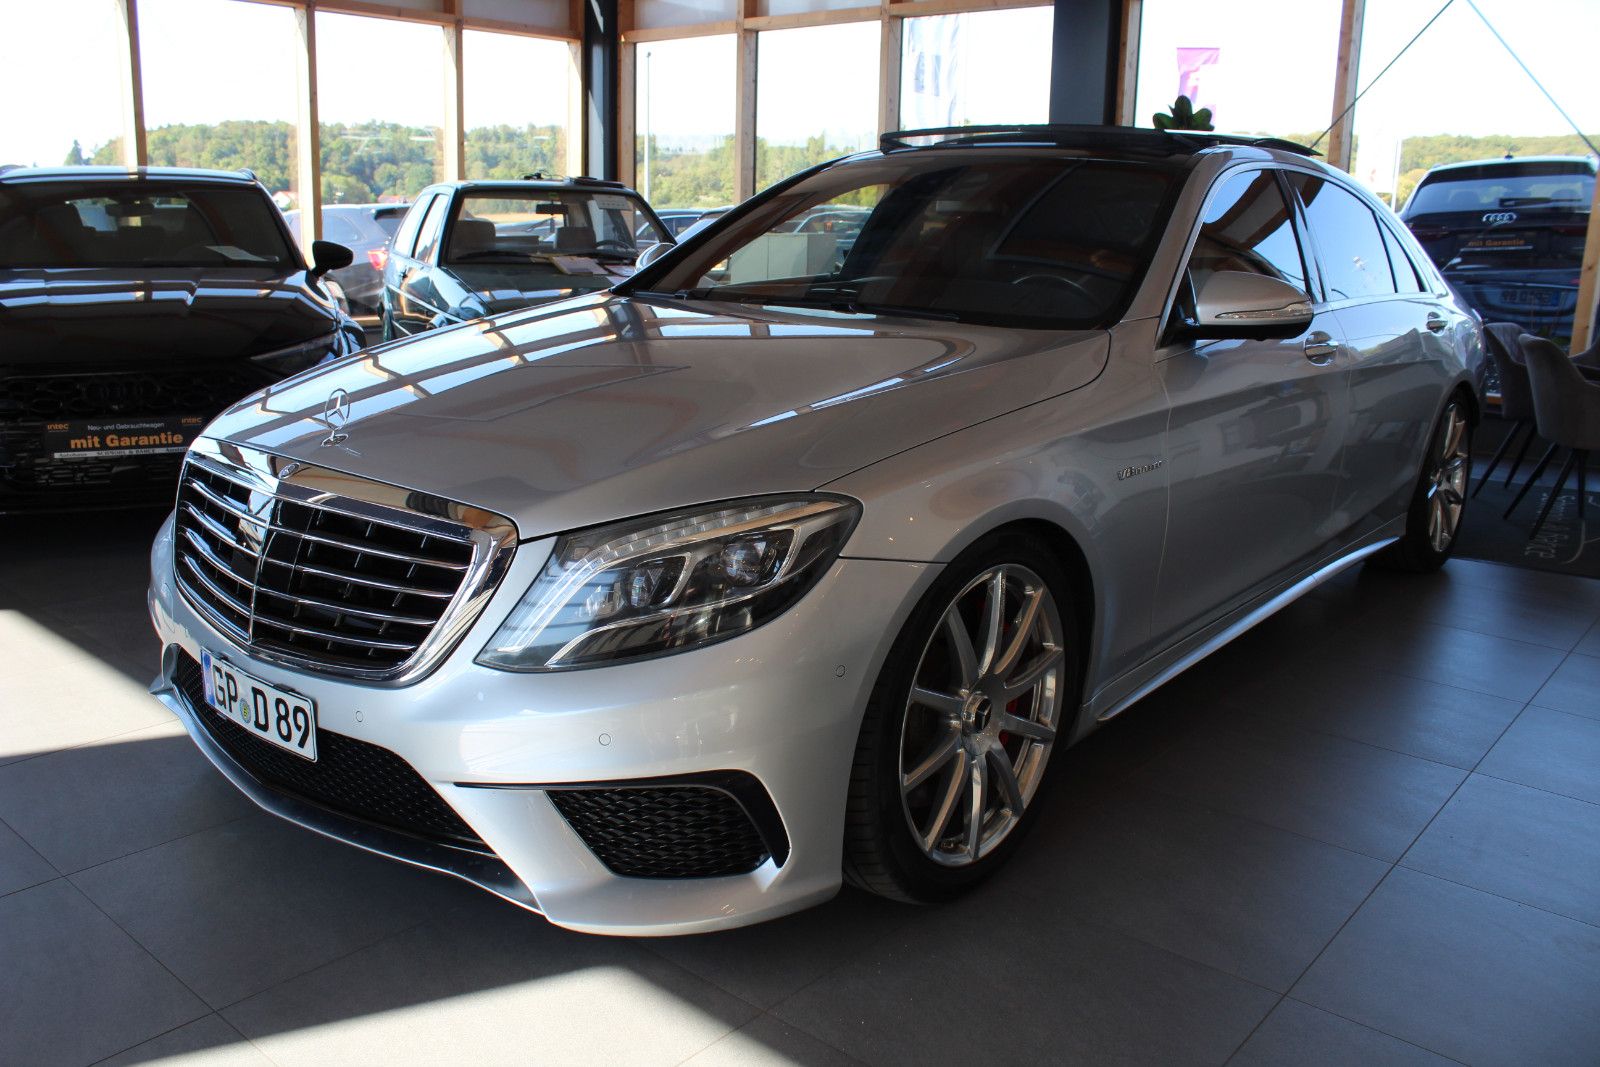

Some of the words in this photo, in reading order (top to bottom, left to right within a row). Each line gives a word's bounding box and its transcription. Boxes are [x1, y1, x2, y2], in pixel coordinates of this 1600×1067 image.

[70, 436, 100, 448] mit
[105, 432, 184, 448] Garantie
[213, 665, 238, 713] GP
[252, 686, 270, 732] D
[275, 698, 310, 748] 89
